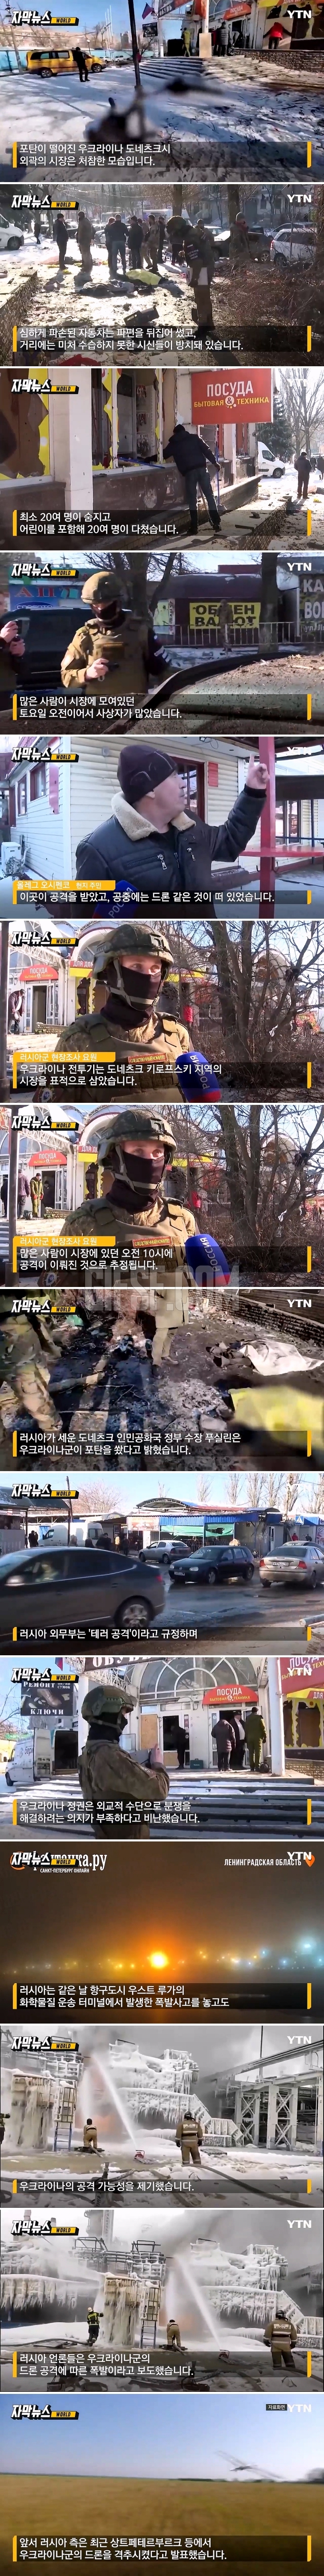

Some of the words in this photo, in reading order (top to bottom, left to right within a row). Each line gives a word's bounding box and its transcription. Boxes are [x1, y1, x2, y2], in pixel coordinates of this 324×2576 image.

[230, 5, 243, 13] ПОСУДА
[207, 380, 254, 397] ПОСУДА
[194, 399, 224, 408] БЫТОВАЯ
[237, 397, 269, 405] ТЕХНИКА
[195, 604, 255, 615] ОБЕН
[199, 1237, 220, 1272] РОССИЯ
[217, 1687, 242, 1696] ПОСУДА
